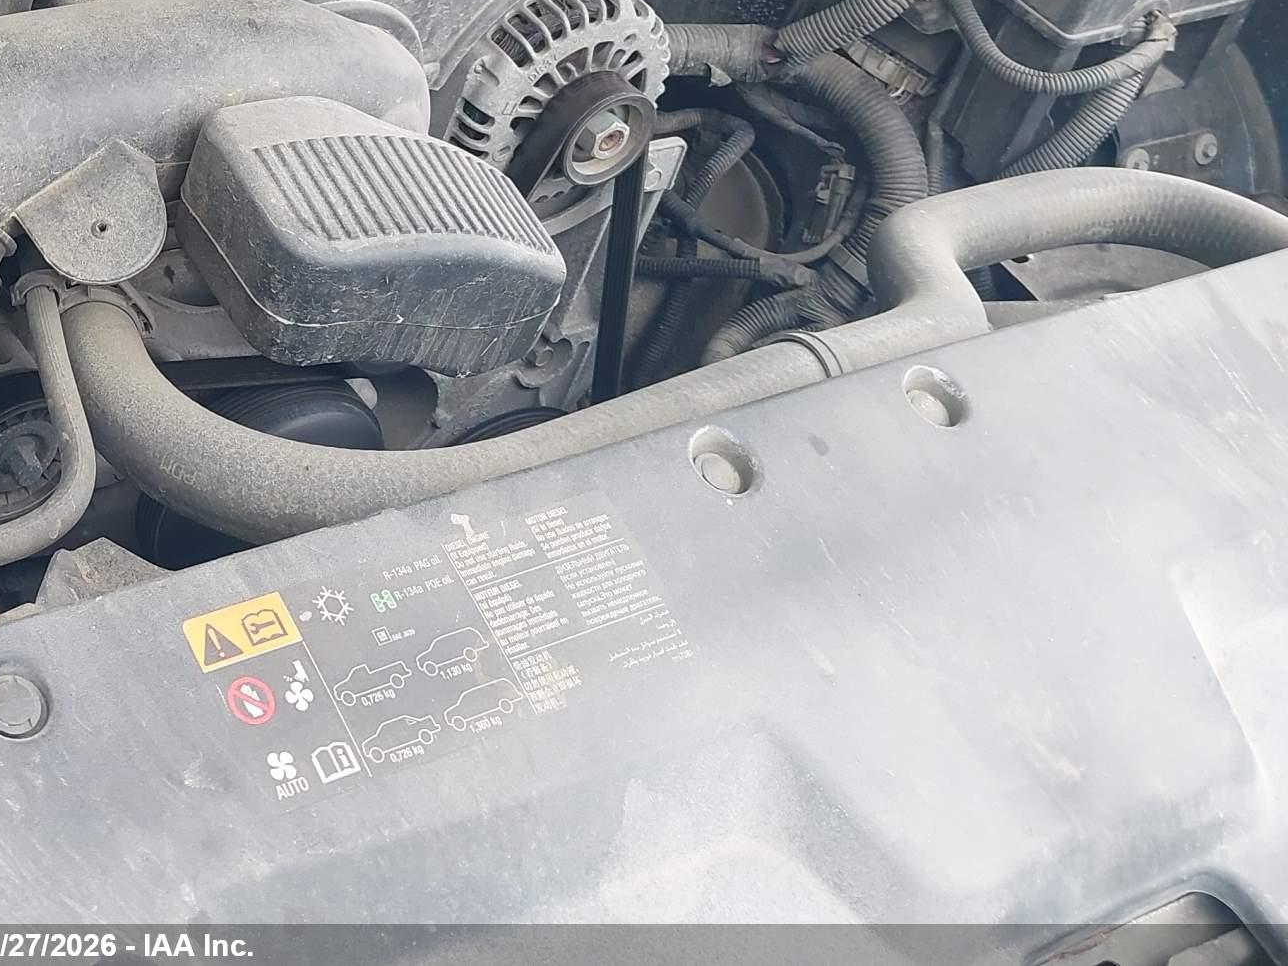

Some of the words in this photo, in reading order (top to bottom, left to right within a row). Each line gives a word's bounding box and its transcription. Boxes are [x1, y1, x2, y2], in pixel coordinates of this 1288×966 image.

[383, 565, 412, 580] R-134a
[413, 559, 430, 569] PAG
[394, 584, 424, 600] R-134a
[425, 578, 442, 589] POE
[461, 662, 473, 672] kg
[383, 687, 396, 699] kg
[491, 716, 503, 726] kg
[411, 743, 425, 755] kg
[275, 776, 309, 799] AUTO
